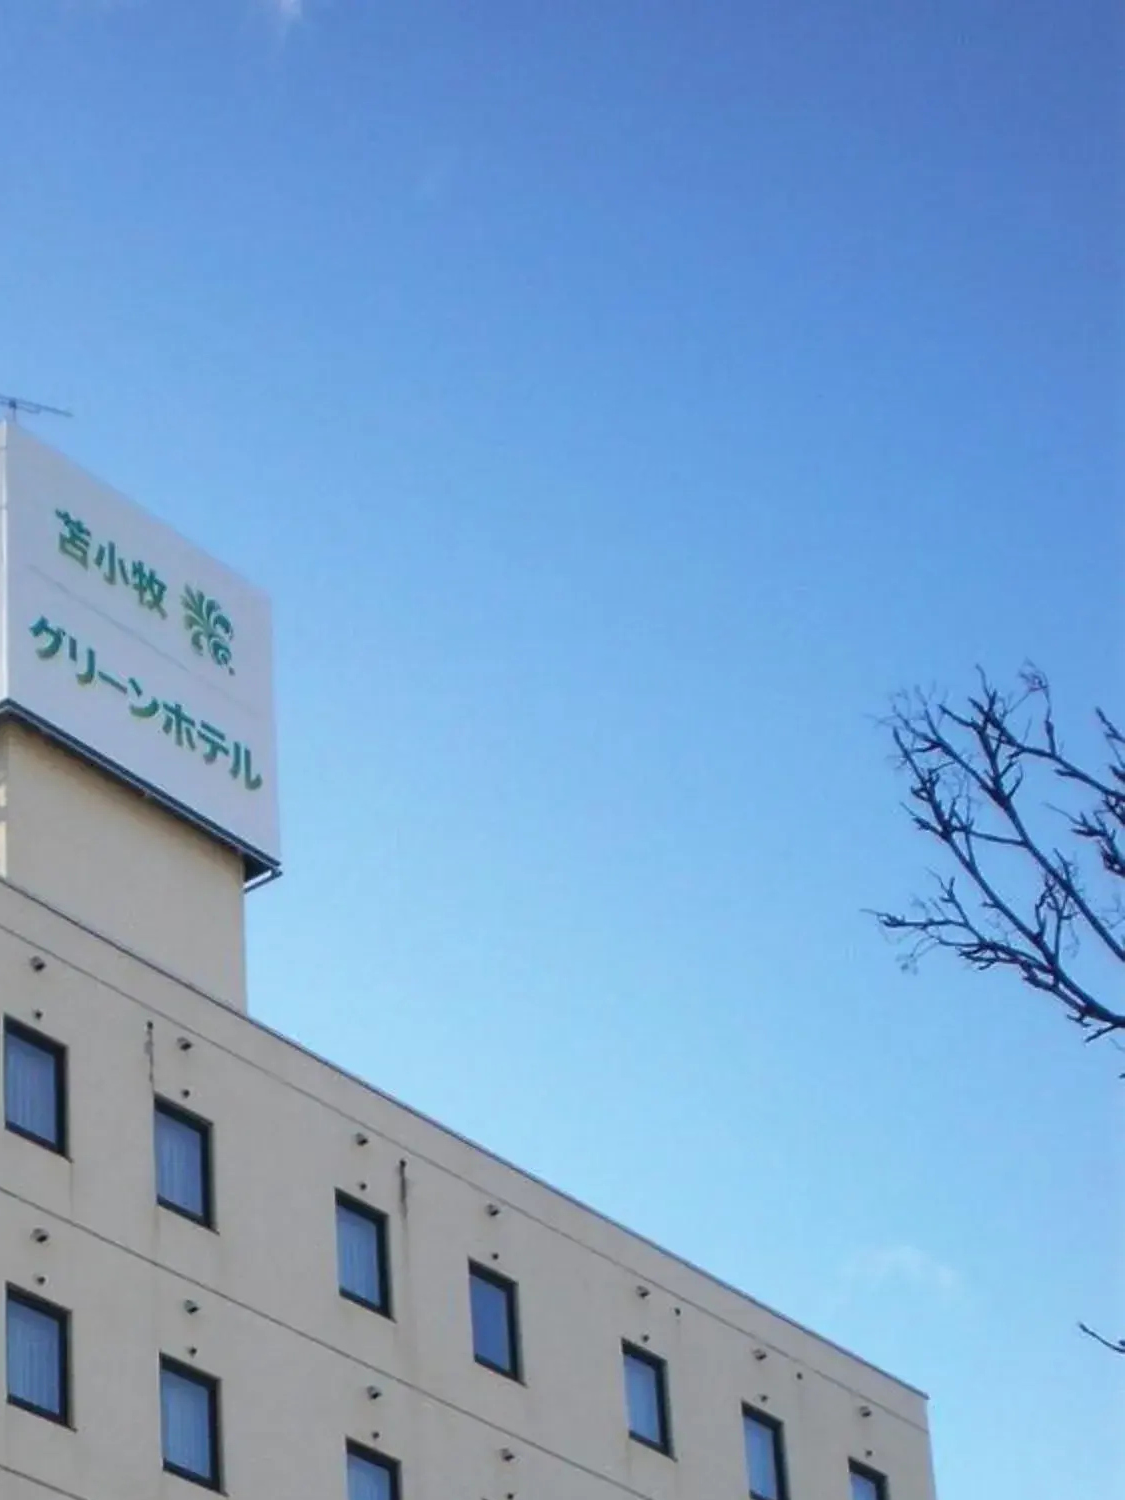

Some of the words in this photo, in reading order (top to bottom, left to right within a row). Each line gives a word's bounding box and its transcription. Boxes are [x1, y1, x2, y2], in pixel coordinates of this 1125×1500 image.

[55, 508, 168, 611] 苫小牧
[29, 615, 263, 791] グリーンホテル
